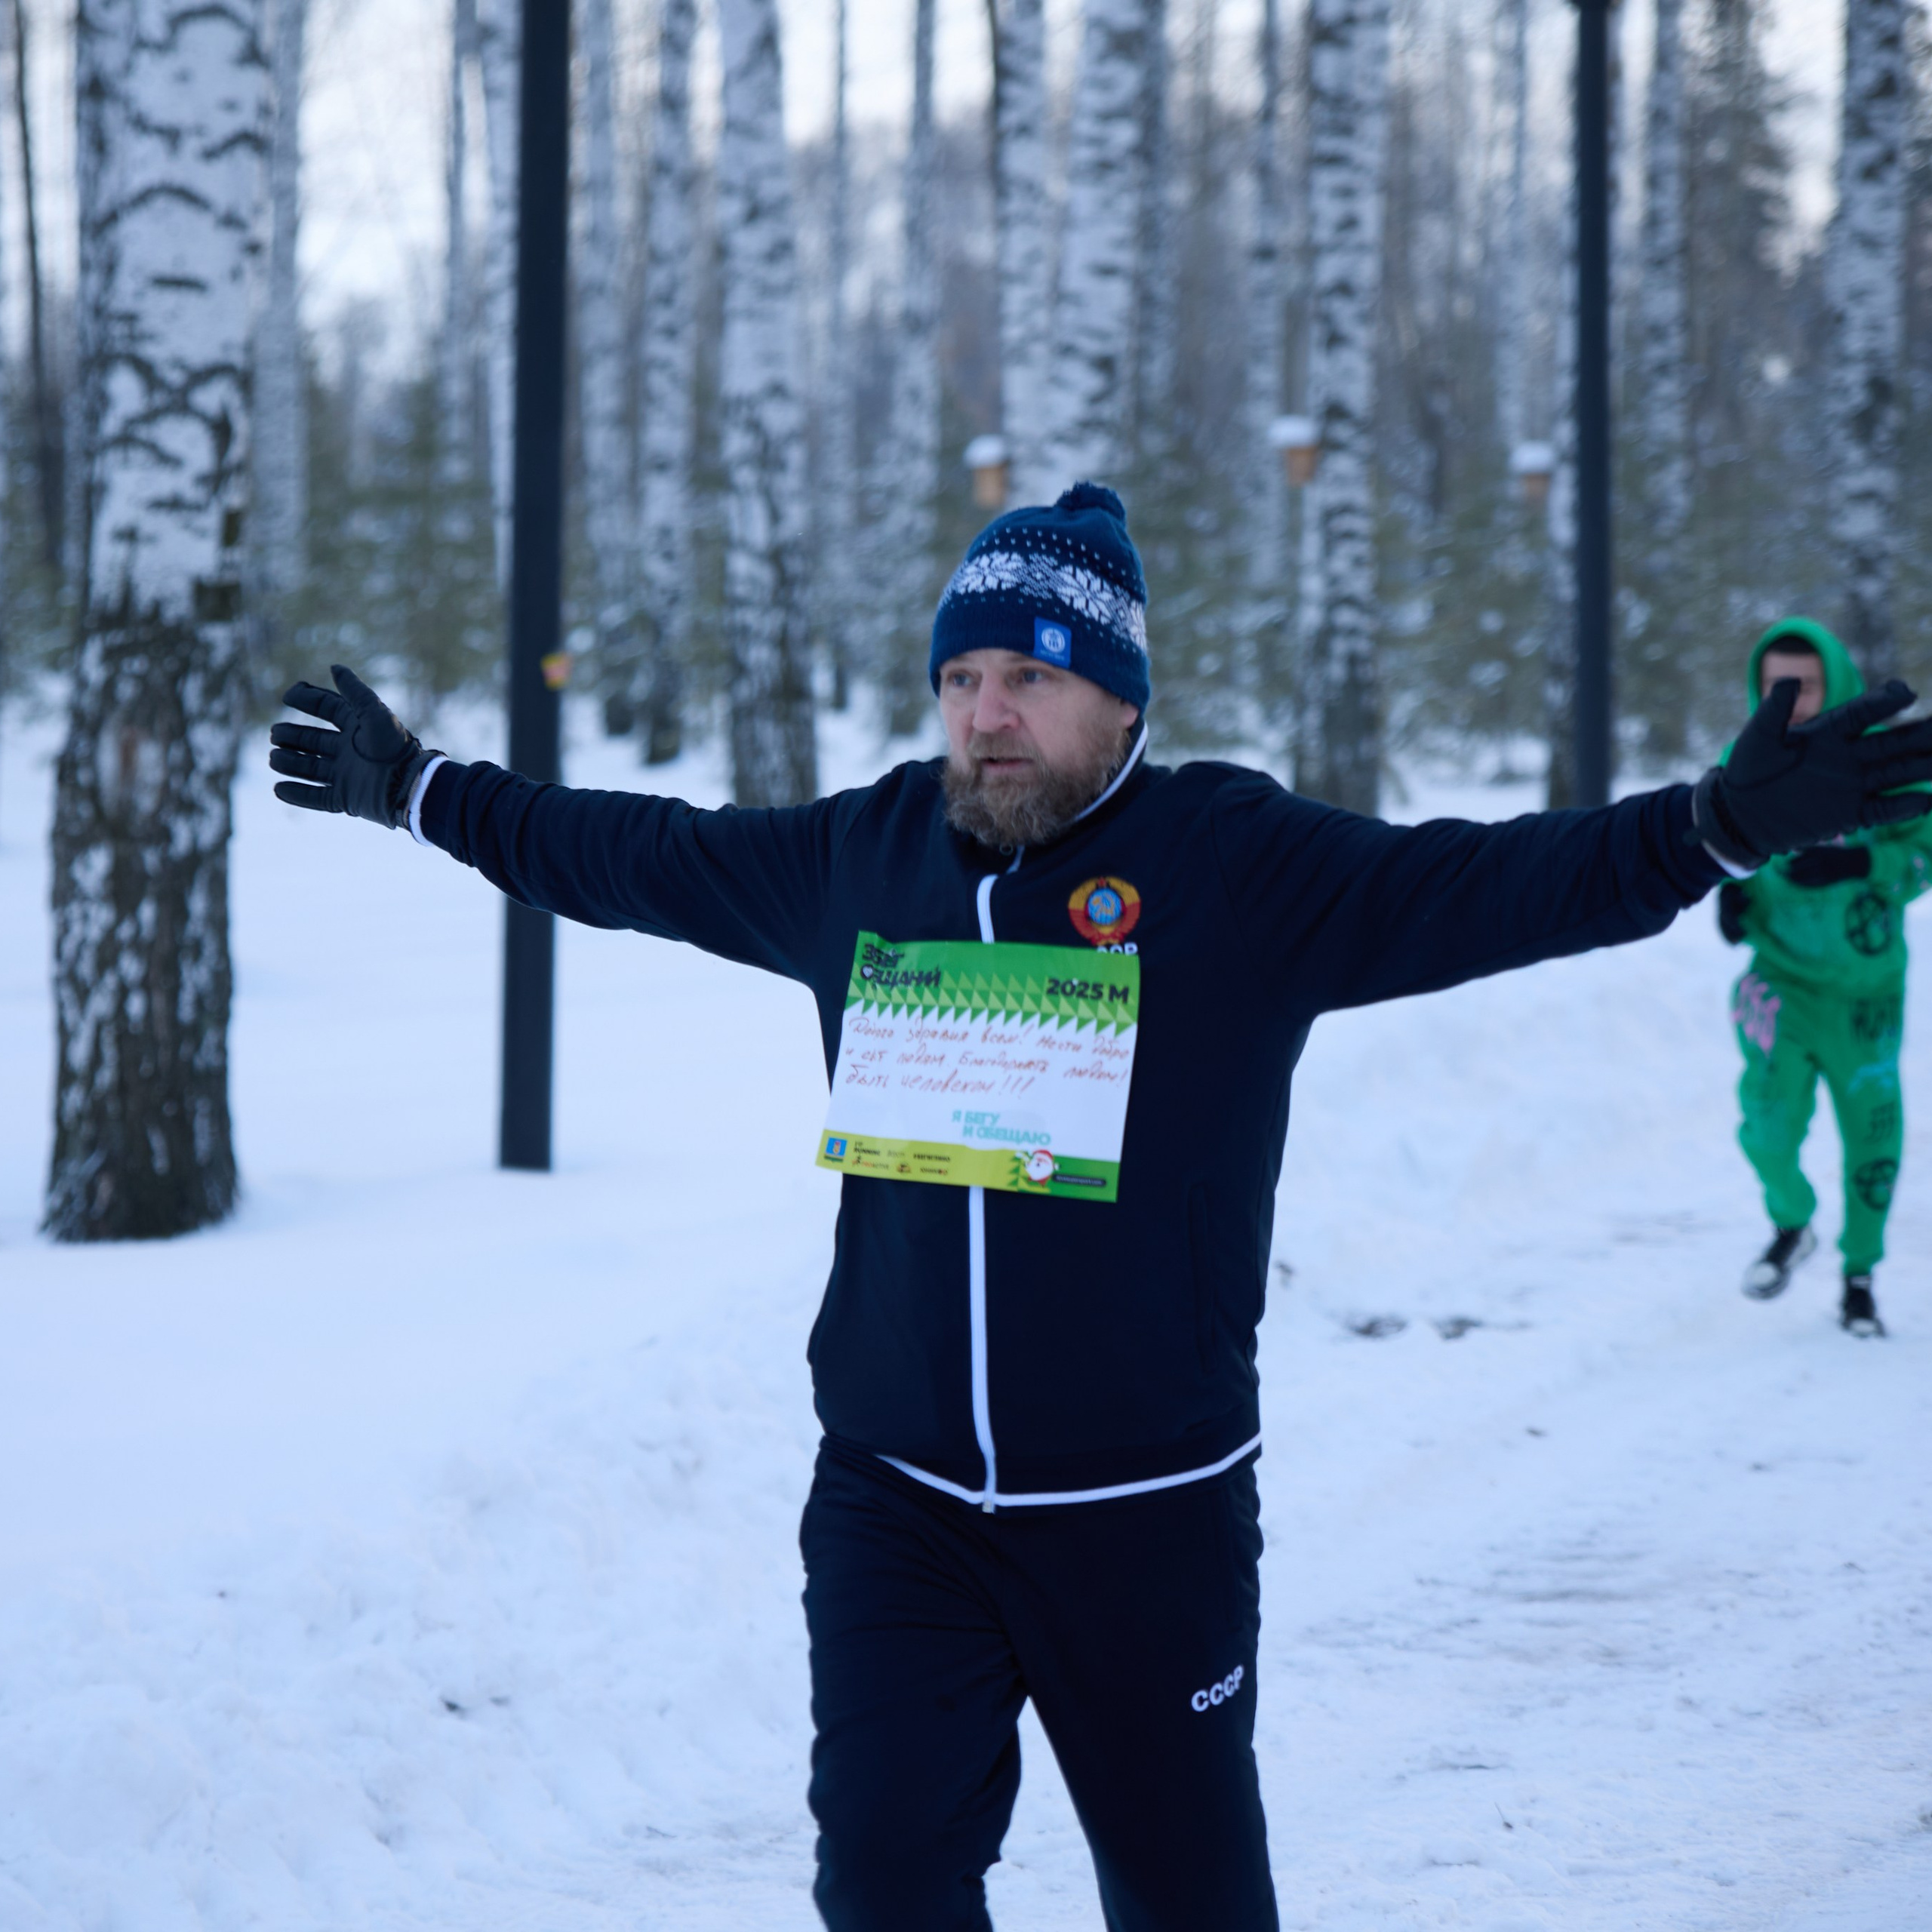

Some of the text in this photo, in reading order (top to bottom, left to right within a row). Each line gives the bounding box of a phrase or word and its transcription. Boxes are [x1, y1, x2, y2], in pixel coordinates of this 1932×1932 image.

[1047, 979, 1129, 1004] 2025 М
[952, 1110, 1000, 1125] Я БЕГУ
[963, 1125, 974, 1138] И
[1191, 1665, 1244, 1712] СССР
